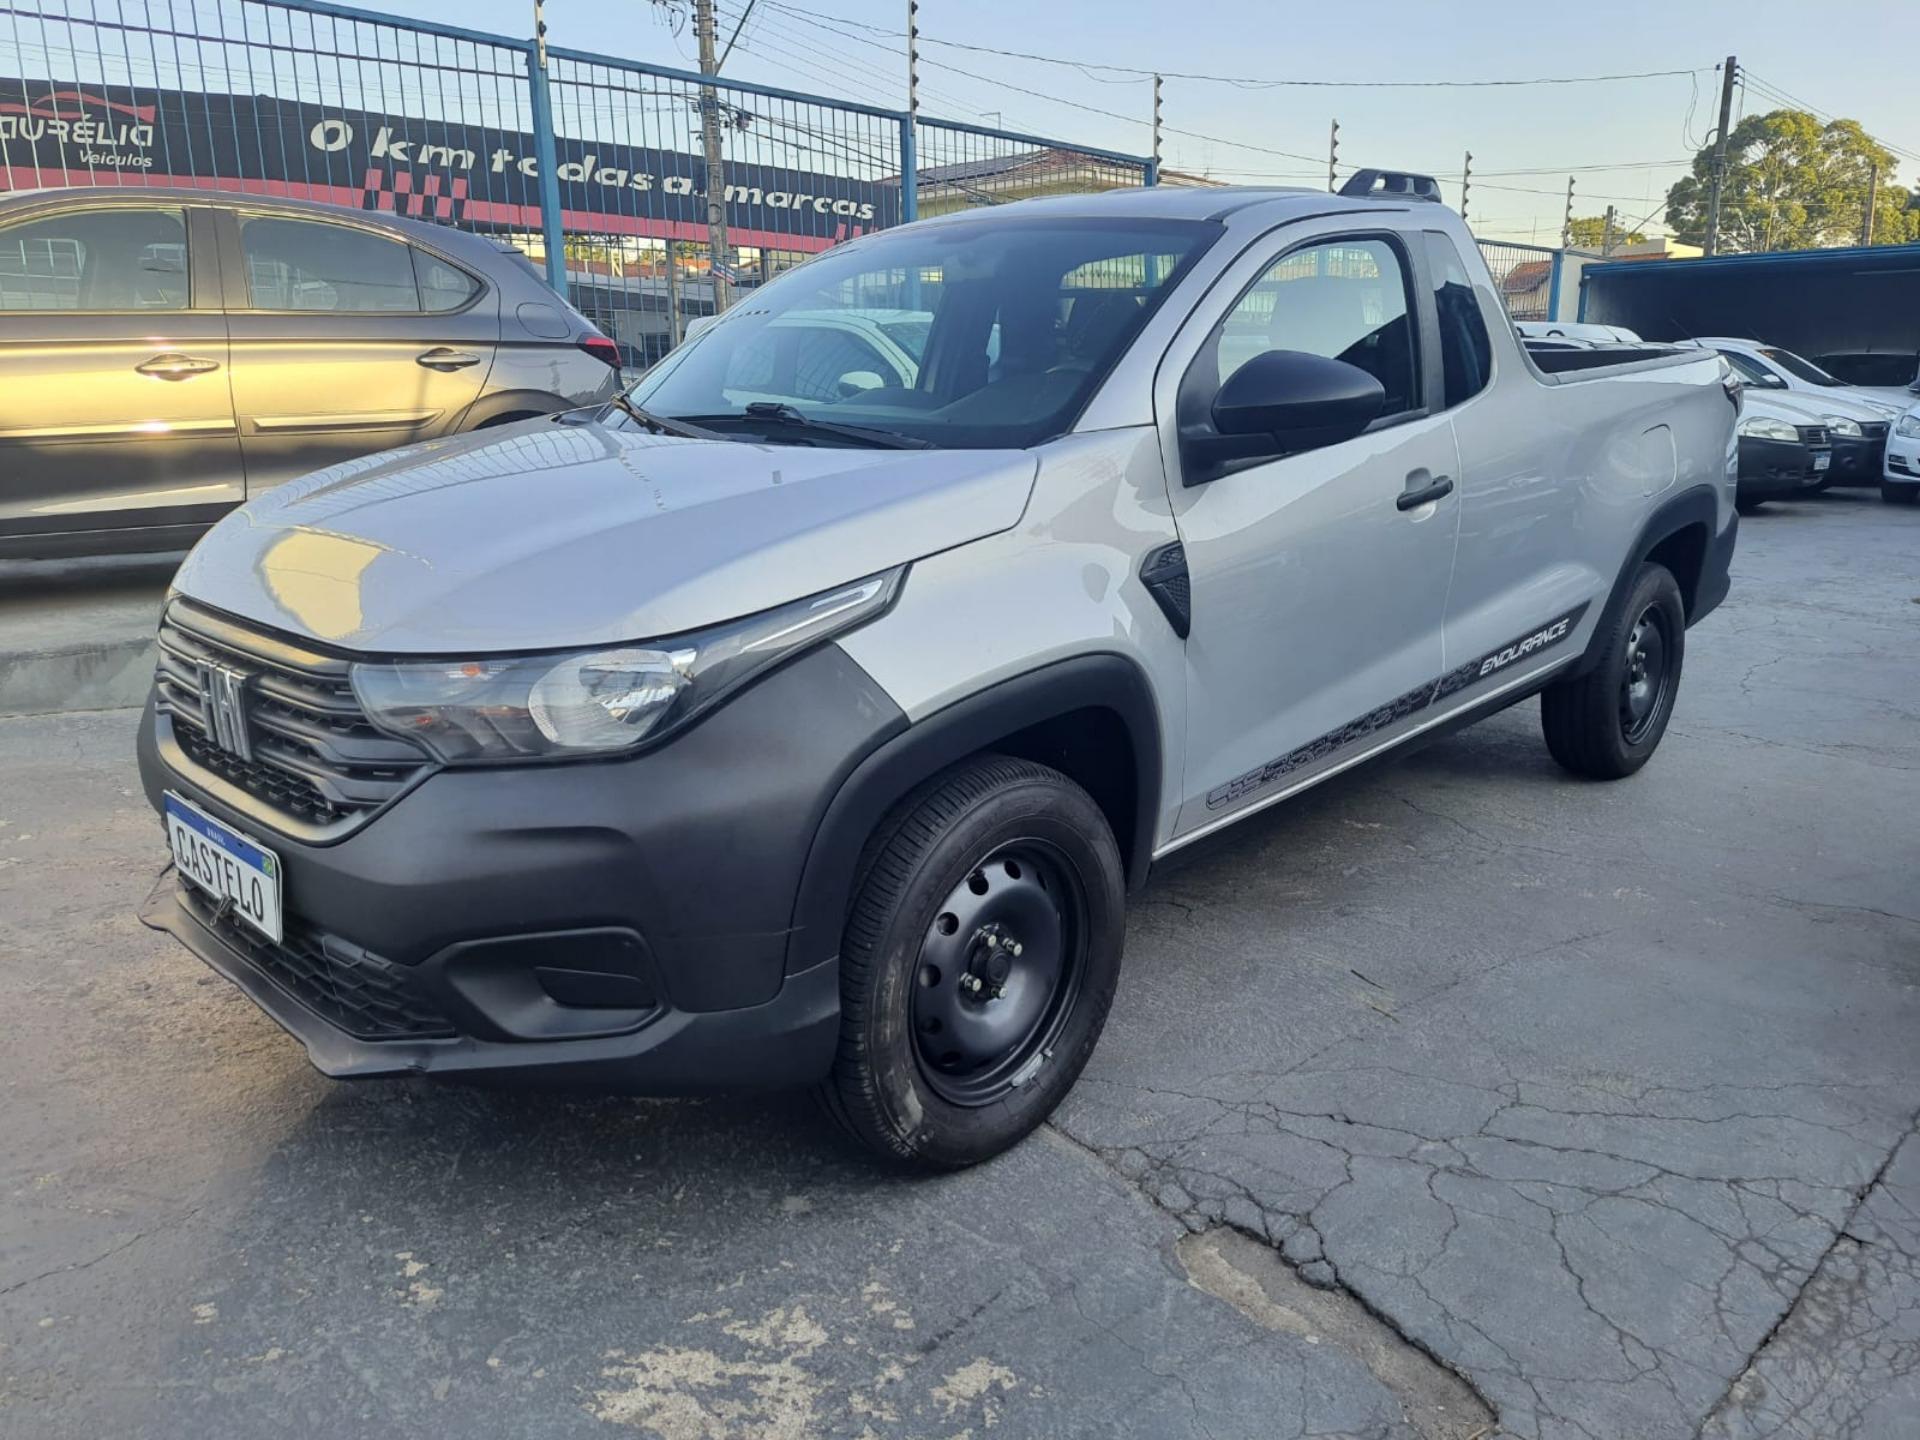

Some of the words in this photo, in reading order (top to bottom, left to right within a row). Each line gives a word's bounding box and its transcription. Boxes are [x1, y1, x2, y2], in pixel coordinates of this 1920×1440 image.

[371, 126, 476, 170] km
[724, 184, 877, 220] marcas
[1479, 618, 1570, 676] ENDURANCE
[176, 825, 264, 923] CASTELO
